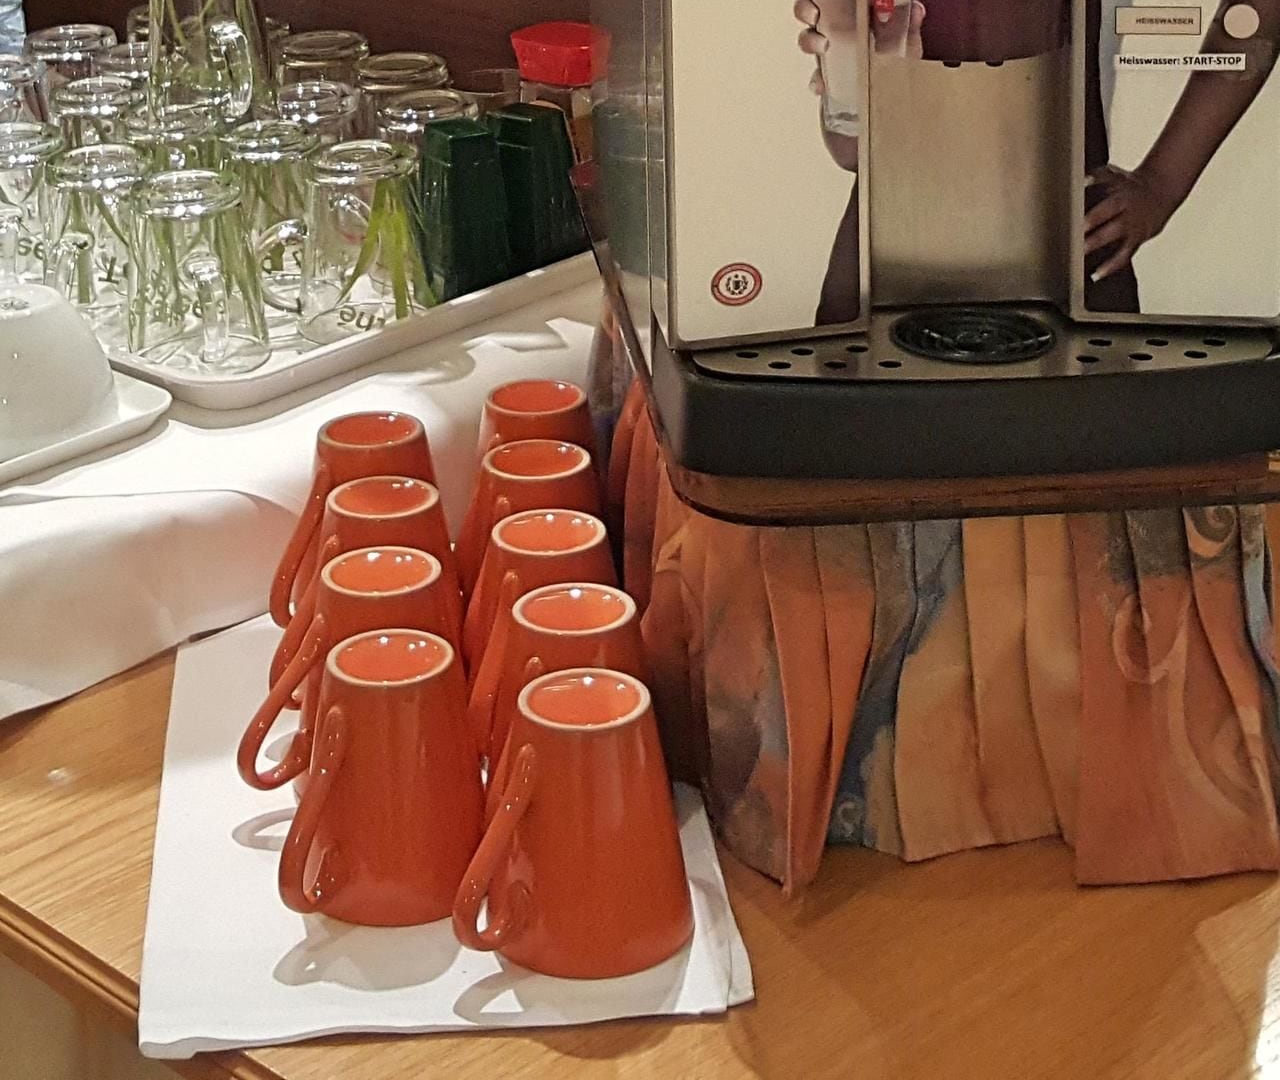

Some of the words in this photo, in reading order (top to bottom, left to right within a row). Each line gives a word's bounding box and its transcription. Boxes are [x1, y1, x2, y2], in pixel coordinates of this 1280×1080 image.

[1136, 17, 1194, 25] HEISSWASSER
[1120, 55, 1181, 66] Heisswasser:
[1183, 55, 1242, 66] START-STOP
